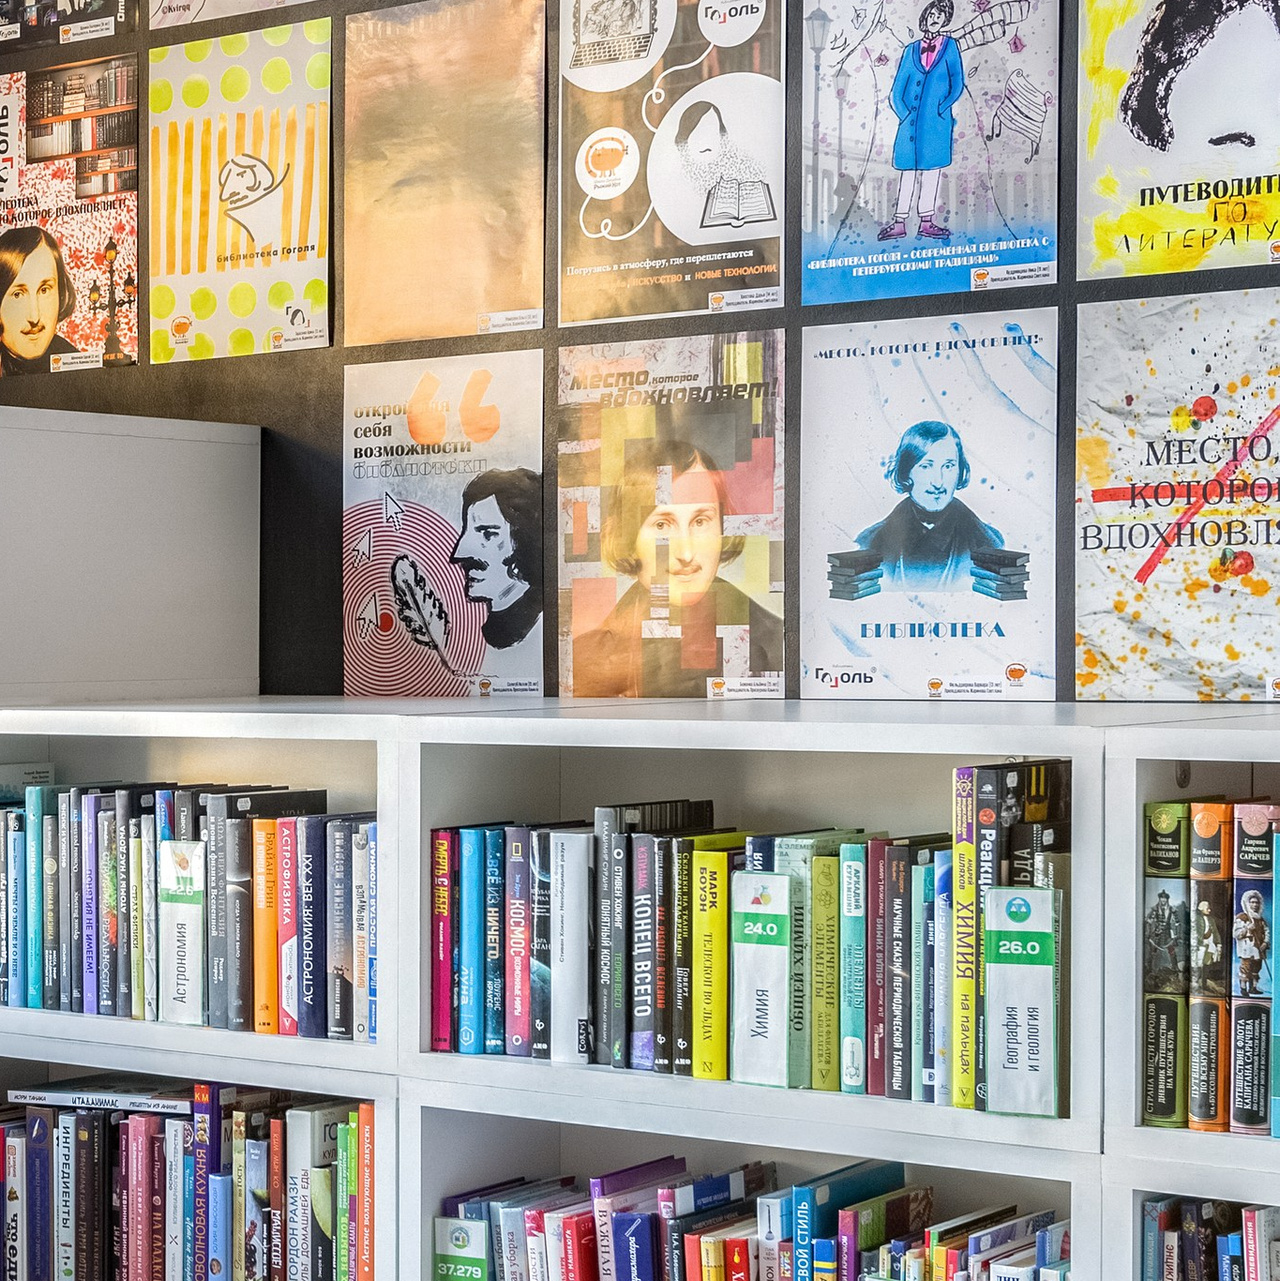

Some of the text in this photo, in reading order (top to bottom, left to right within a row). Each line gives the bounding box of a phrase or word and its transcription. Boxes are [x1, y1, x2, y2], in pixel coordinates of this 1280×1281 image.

[217, 243, 316, 263] библиотека Гоголя
[599, 378, 778, 408] вдохновляет!
[354, 421, 392, 439] себя
[354, 441, 472, 459] возможности
[860, 622, 1006, 639] БИБЛИОТЕКА
[1239, 851, 1270, 861] САРЫЧЕВ
[699, 867, 707, 912] БОУЭН
[708, 870, 718, 910] МАРК
[509, 899, 524, 957] КОСМОС
[744, 922, 778, 936] 24.0
[957, 900, 974, 980] ХИМИЯ
[172, 922, 187, 1005] Астрономия
[633, 894, 651, 1017] КОНЕЦ ВСЕГО
[793, 904, 805, 1032] ОБЩЕЙ ХИМИИ
[999, 942, 1040, 955] 26.0
[751, 989, 769, 1039] Химия
[1003, 1005, 1018, 1070] География
[62, 1125, 71, 1229] ИНГРЕДИЕНТЫ
[437, 1262, 483, 1280] 37.279
